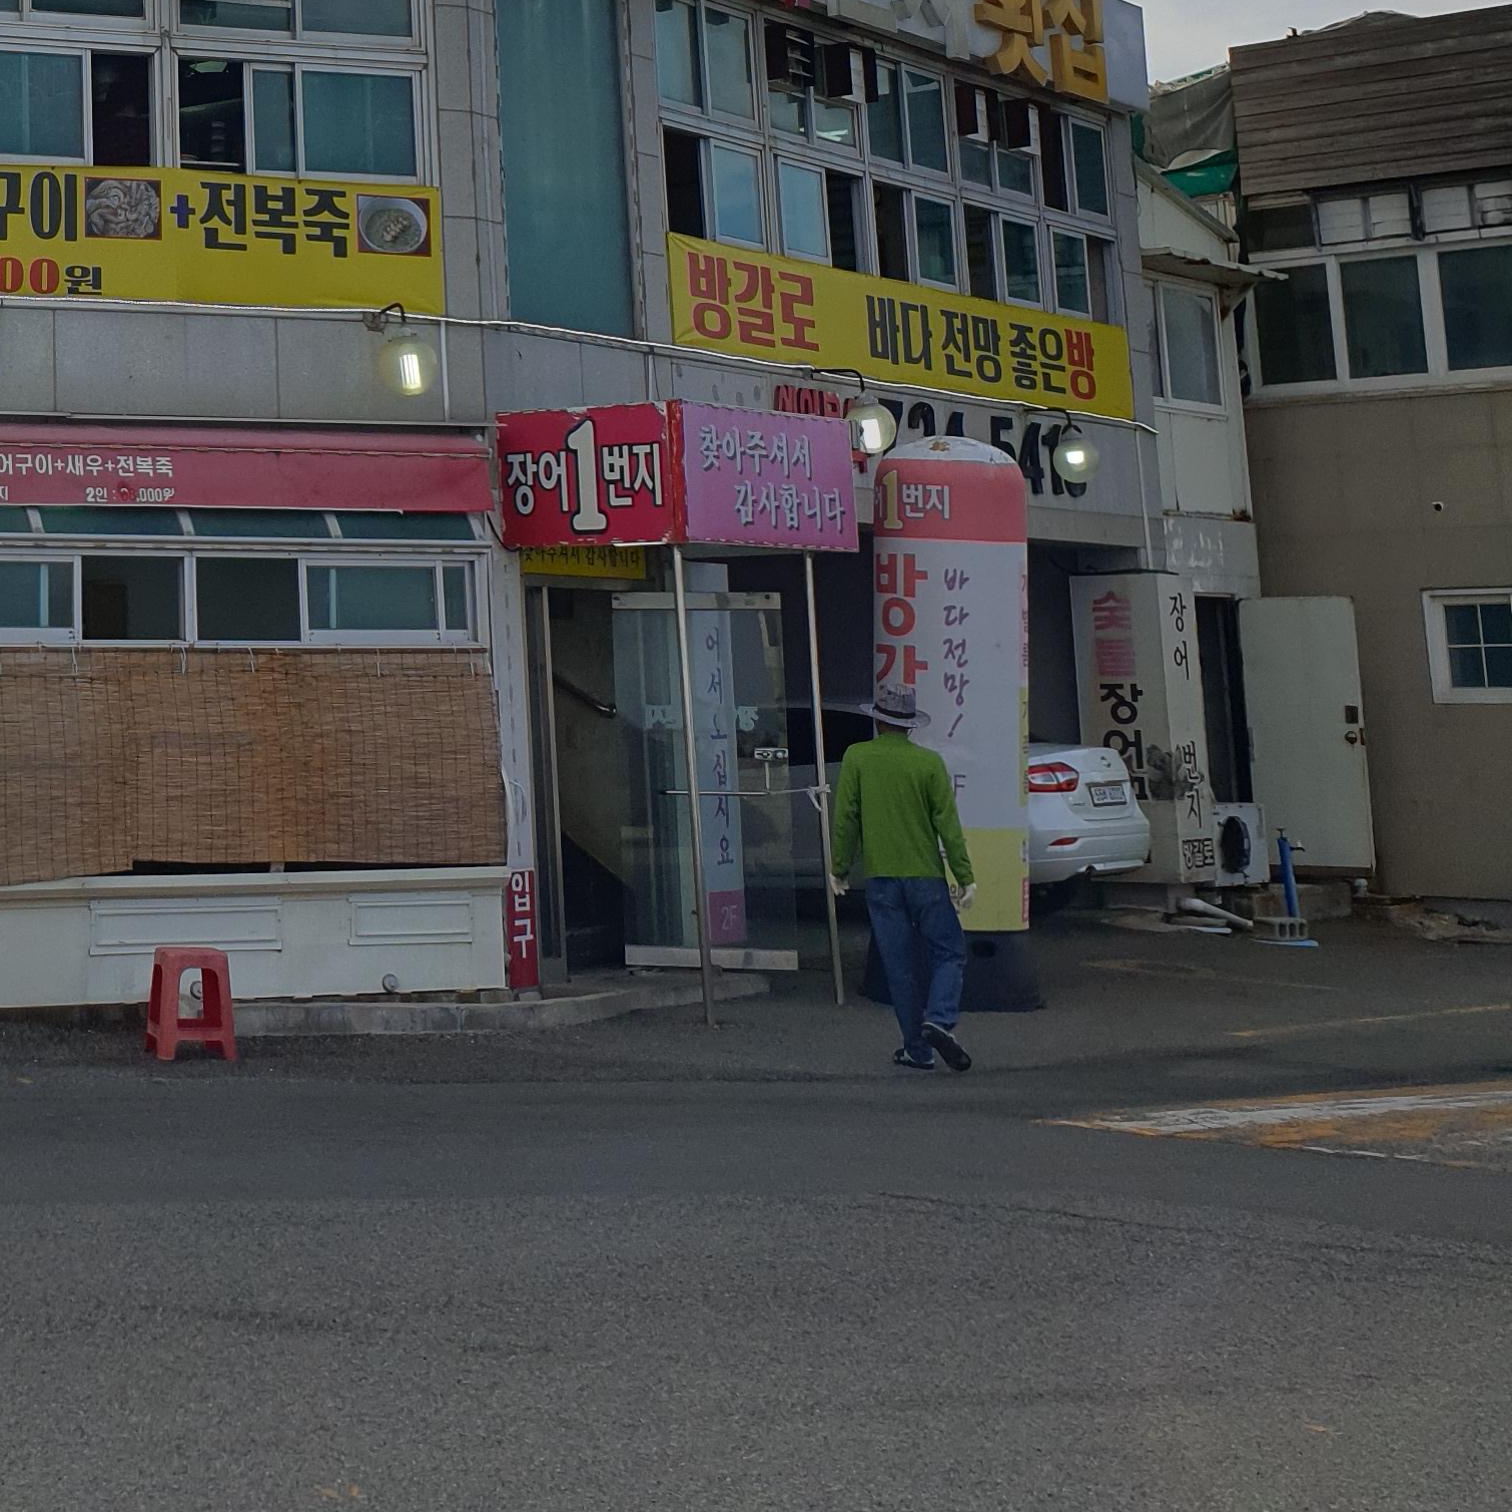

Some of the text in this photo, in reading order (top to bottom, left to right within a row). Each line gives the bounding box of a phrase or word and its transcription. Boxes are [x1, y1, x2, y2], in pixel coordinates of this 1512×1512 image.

[687, 251, 820, 353] 방갈로
[865, 294, 933, 372] 바다
[506, 418, 663, 534] 장어1번지
[699, 424, 812, 480] 찾아주셔서
[734, 482, 846, 532] 감사합니다
[511, 871, 534, 959] 입구
[720, 905, 738, 931] 2F
